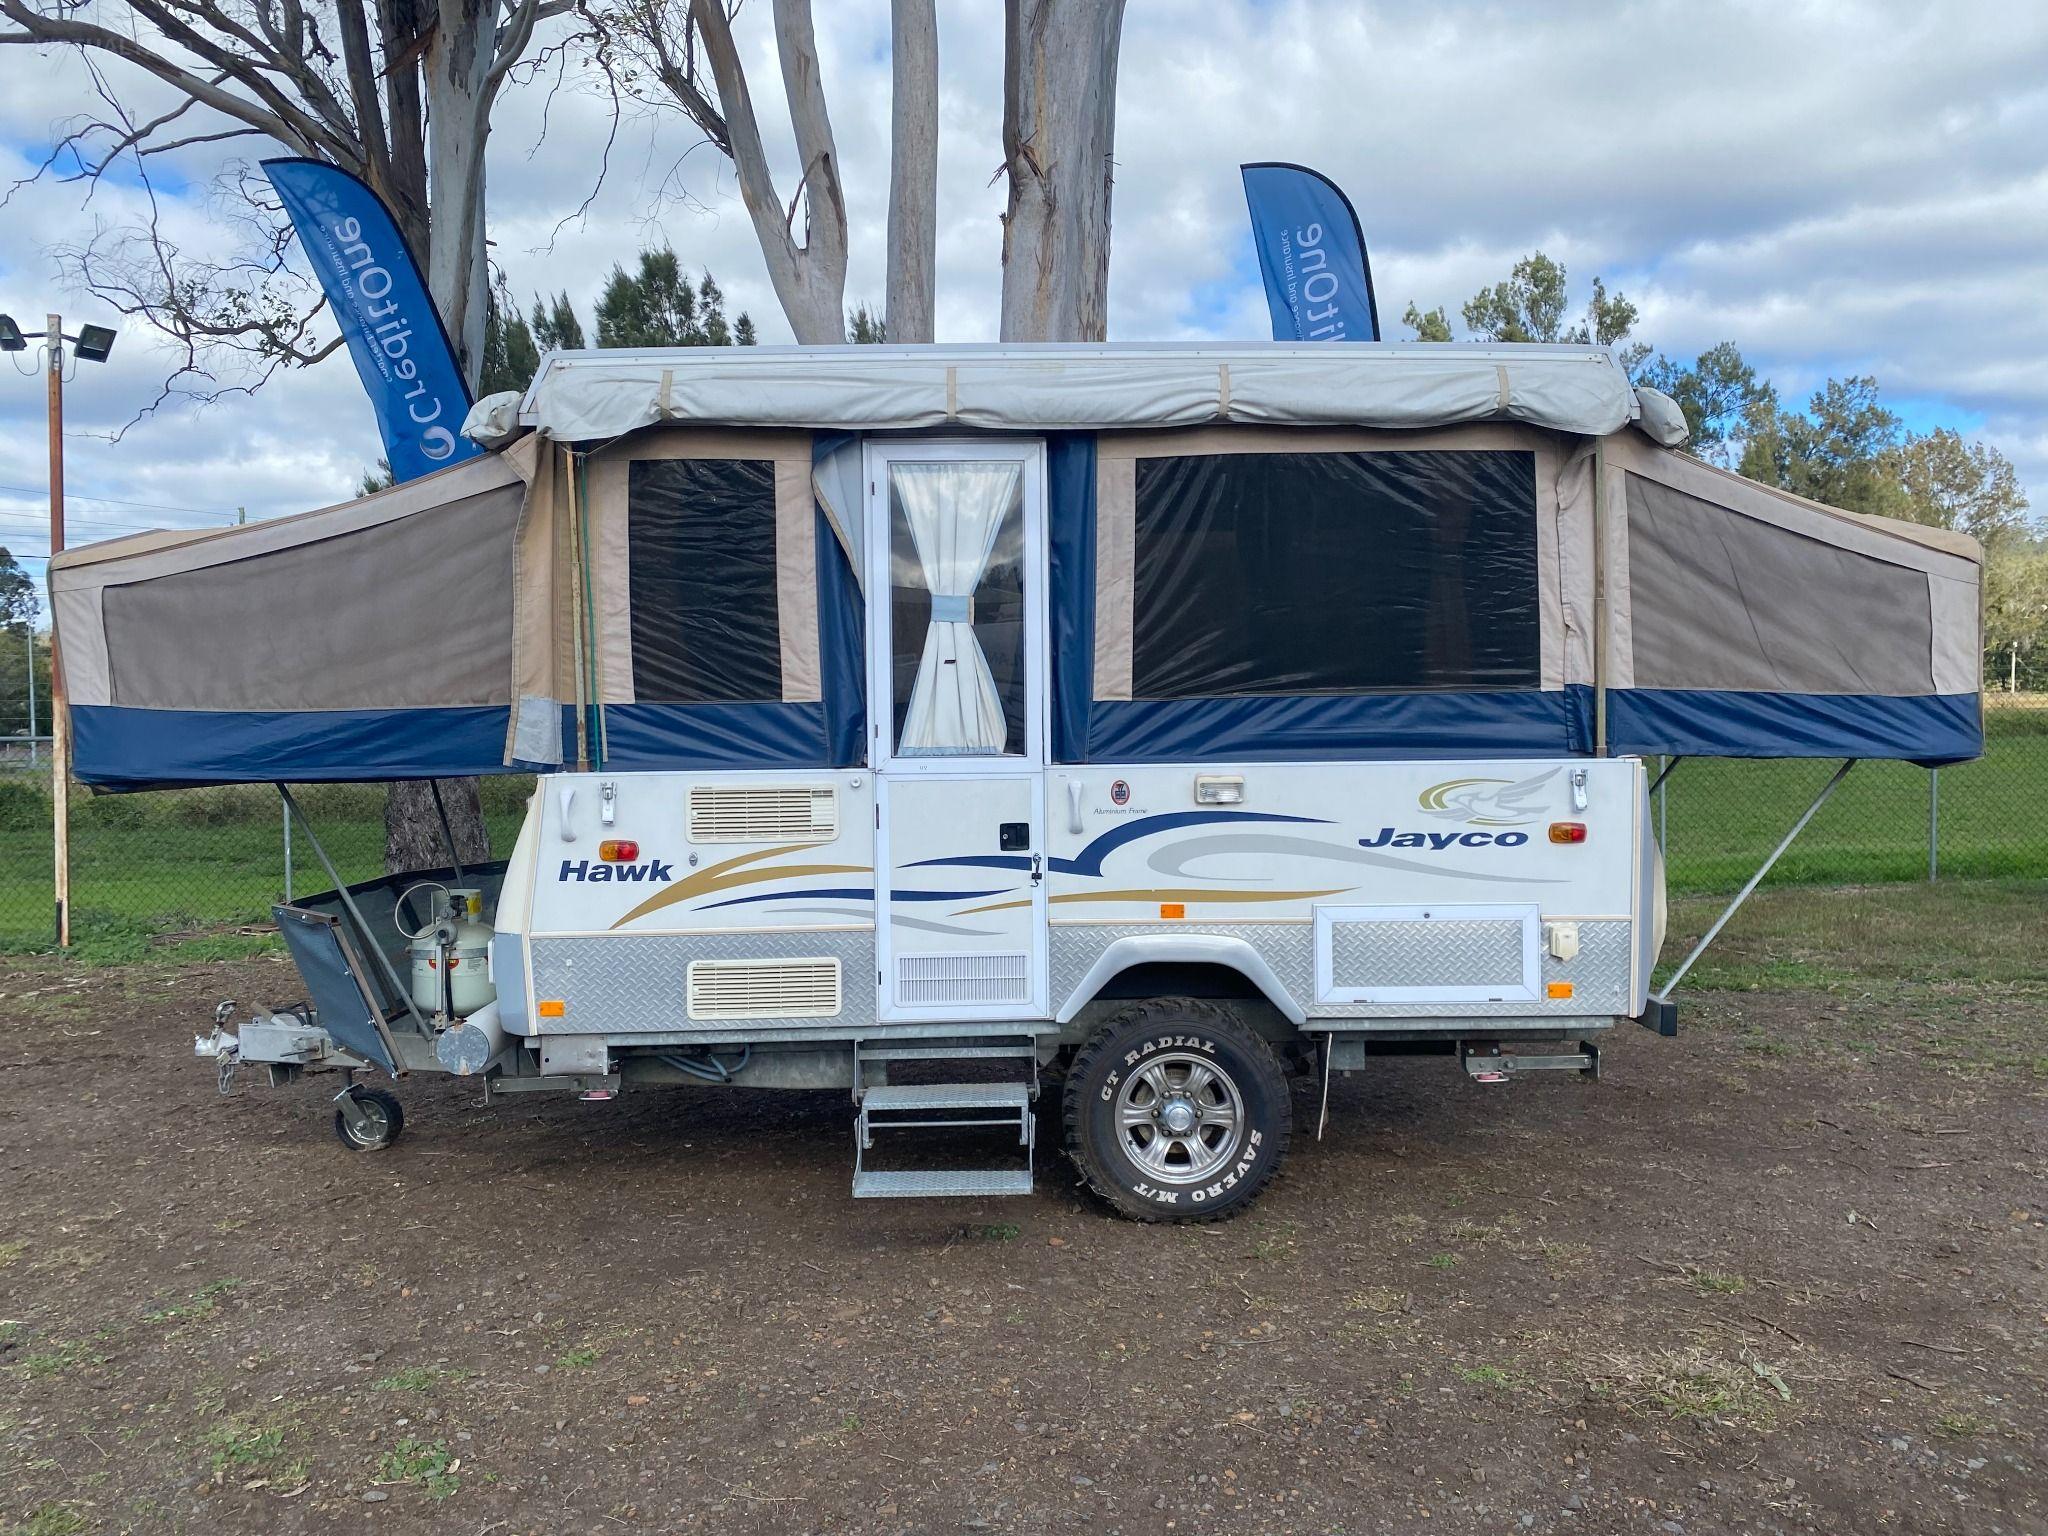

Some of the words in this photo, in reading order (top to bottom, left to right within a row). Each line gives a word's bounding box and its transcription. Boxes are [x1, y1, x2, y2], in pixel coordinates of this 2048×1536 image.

[1358, 827, 1529, 850] Jayco
[558, 859, 674, 882] Hawk
[1101, 1069, 1120, 1101] GT
[1124, 1035, 1216, 1067] RADIAL
[1191, 1129, 1263, 1202] SAVERO
[1132, 1182, 1179, 1204] M/T
